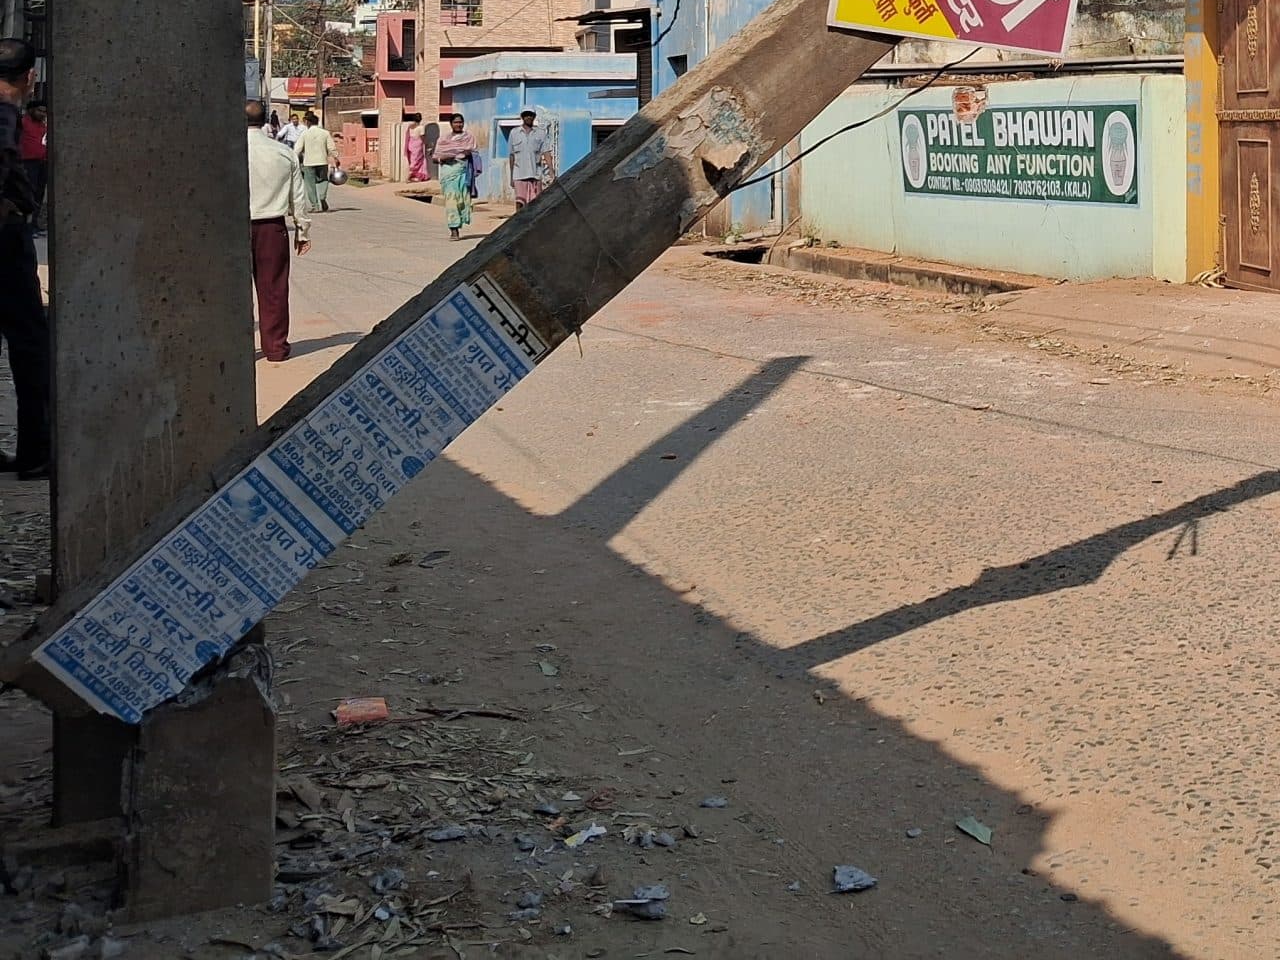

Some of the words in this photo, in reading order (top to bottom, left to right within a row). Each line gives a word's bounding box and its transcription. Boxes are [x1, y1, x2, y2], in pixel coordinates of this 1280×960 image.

[927, 113, 985, 147] PATEL
[992, 110, 1095, 148] BHAWAN
[929, 152, 979, 173] BOOKING
[986, 154, 1012, 174] ANY
[1016, 154, 1095, 177] FUNCTION
[927, 175, 951, 191] CONTACT
[463, 341, 495, 373] गुप्त
[366, 372, 430, 439] बवासीर
[340, 392, 402, 459] भगंदर
[281, 441, 305, 469] Mob.
[260, 517, 297, 550] गुप्त
[152, 558, 225, 621] बवासीर
[123, 580, 194, 644] भगंदर
[60, 635, 86, 662] Mob.
